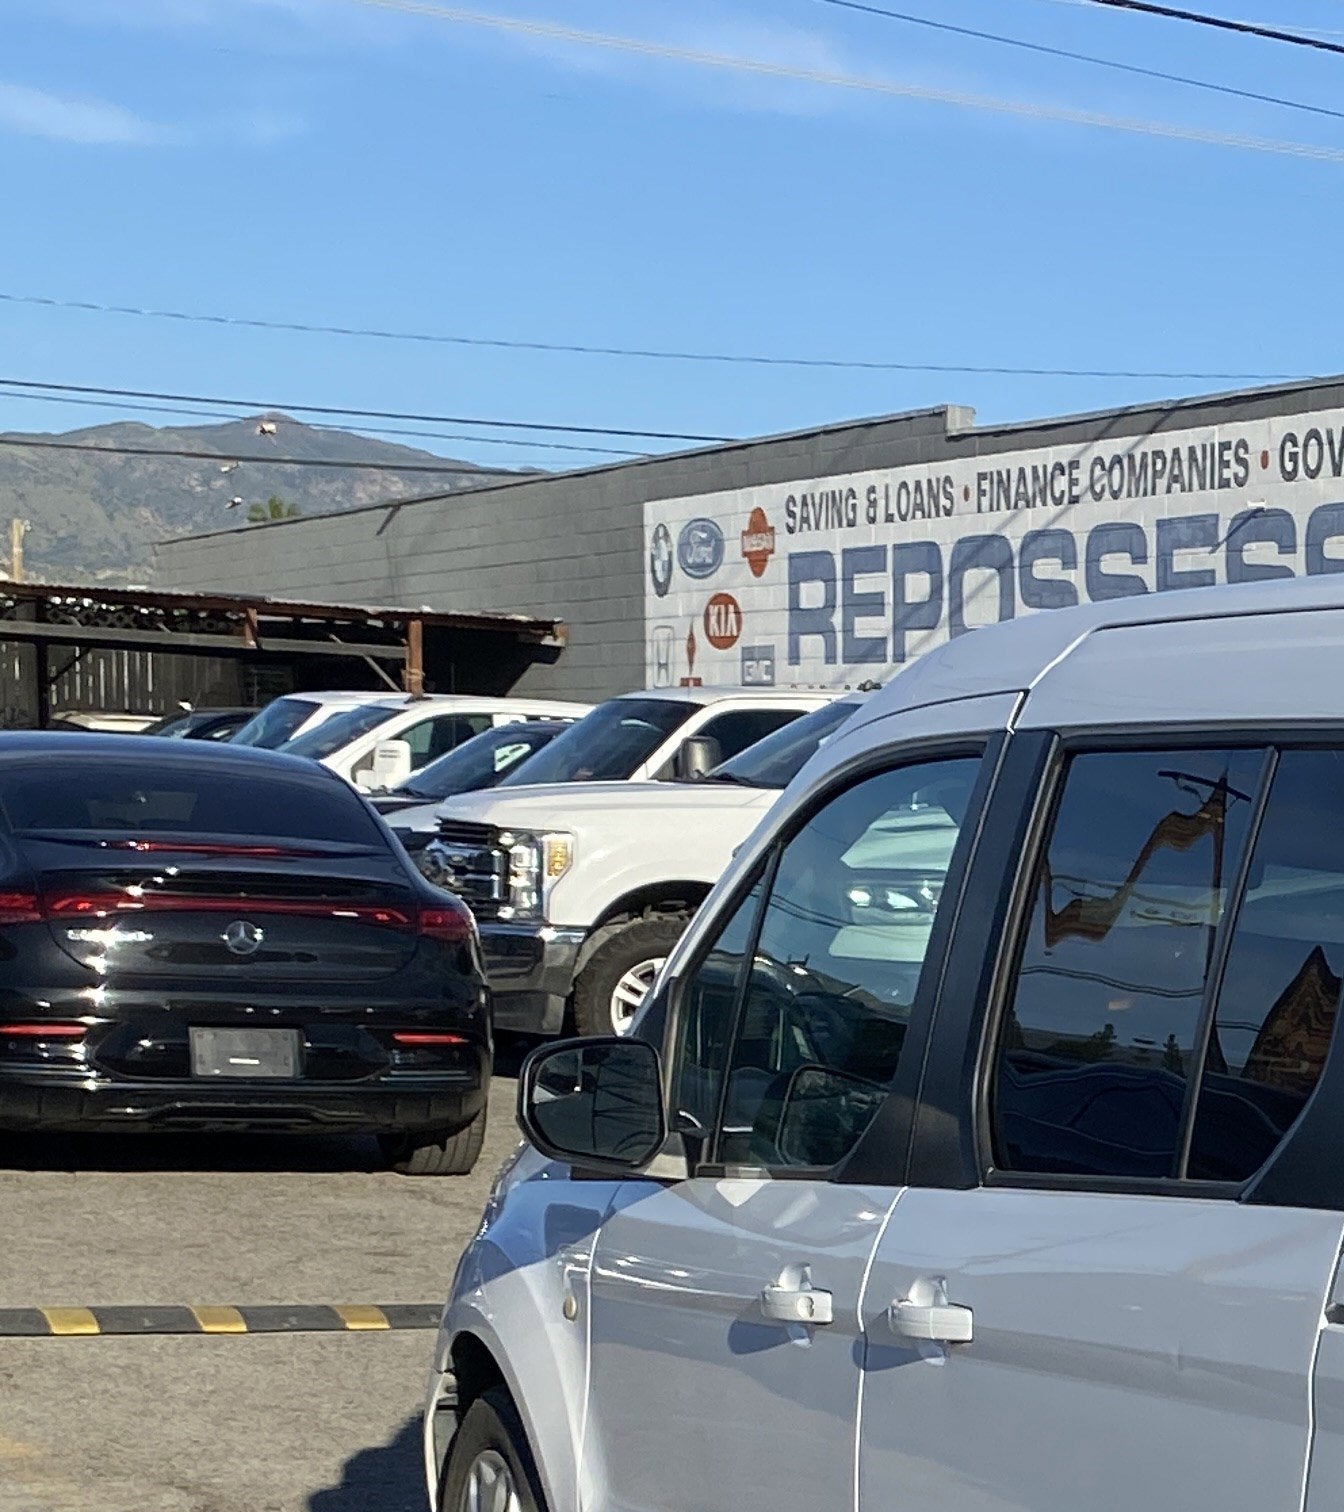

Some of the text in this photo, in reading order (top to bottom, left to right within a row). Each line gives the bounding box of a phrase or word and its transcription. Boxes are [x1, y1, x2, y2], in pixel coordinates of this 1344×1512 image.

[785, 488, 857, 534] SAVING
[884, 475, 954, 523] LOANS
[976, 457, 1079, 514] FINANCE
[1089, 438, 1249, 501] COMPANIES
[708, 604, 738, 637] KIA
